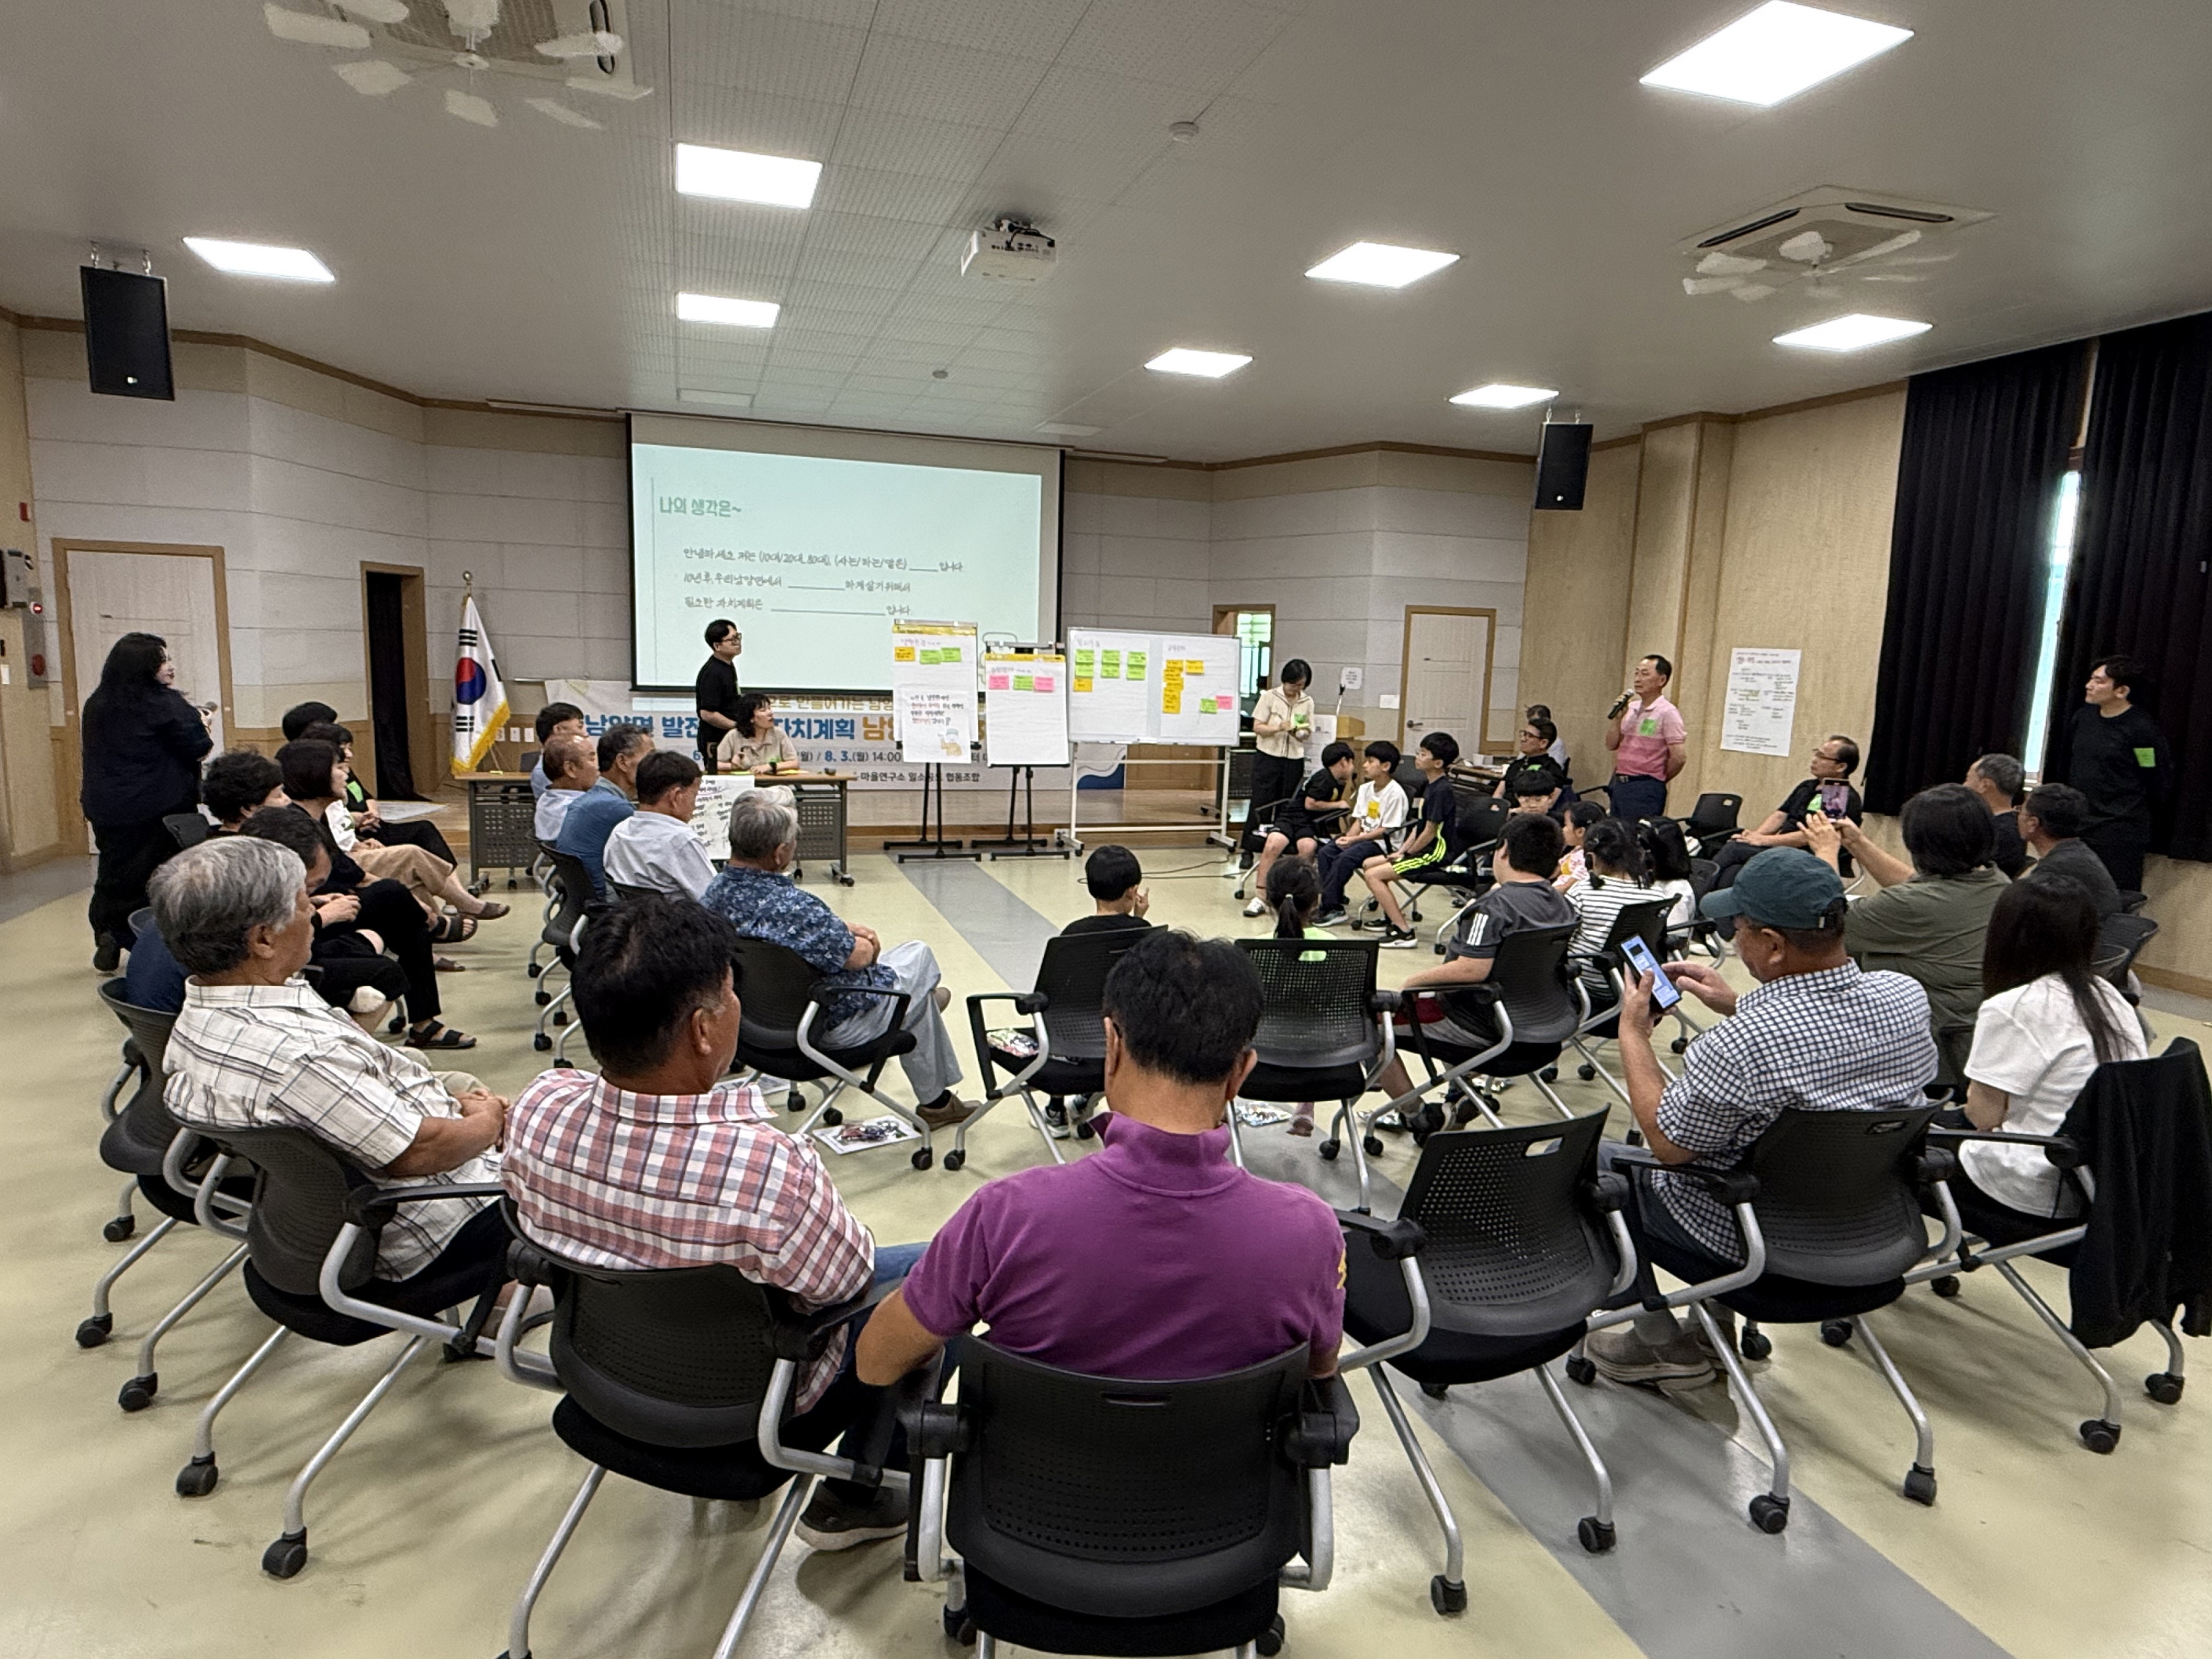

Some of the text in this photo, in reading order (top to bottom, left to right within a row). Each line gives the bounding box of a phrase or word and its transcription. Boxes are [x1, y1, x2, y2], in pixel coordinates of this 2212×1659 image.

[660, 497, 687, 514] 나의
[738, 550, 756, 562] 저는
[685, 596, 714, 609] 필요한
[716, 597, 763, 610] 자치계획은
[796, 694, 865, 712] 만들어가는
[796, 751, 813, 762] 월)
[872, 752, 901, 762] 14:00
[860, 771, 905, 782] 마을연구소
[946, 773, 980, 783] 협동조합
